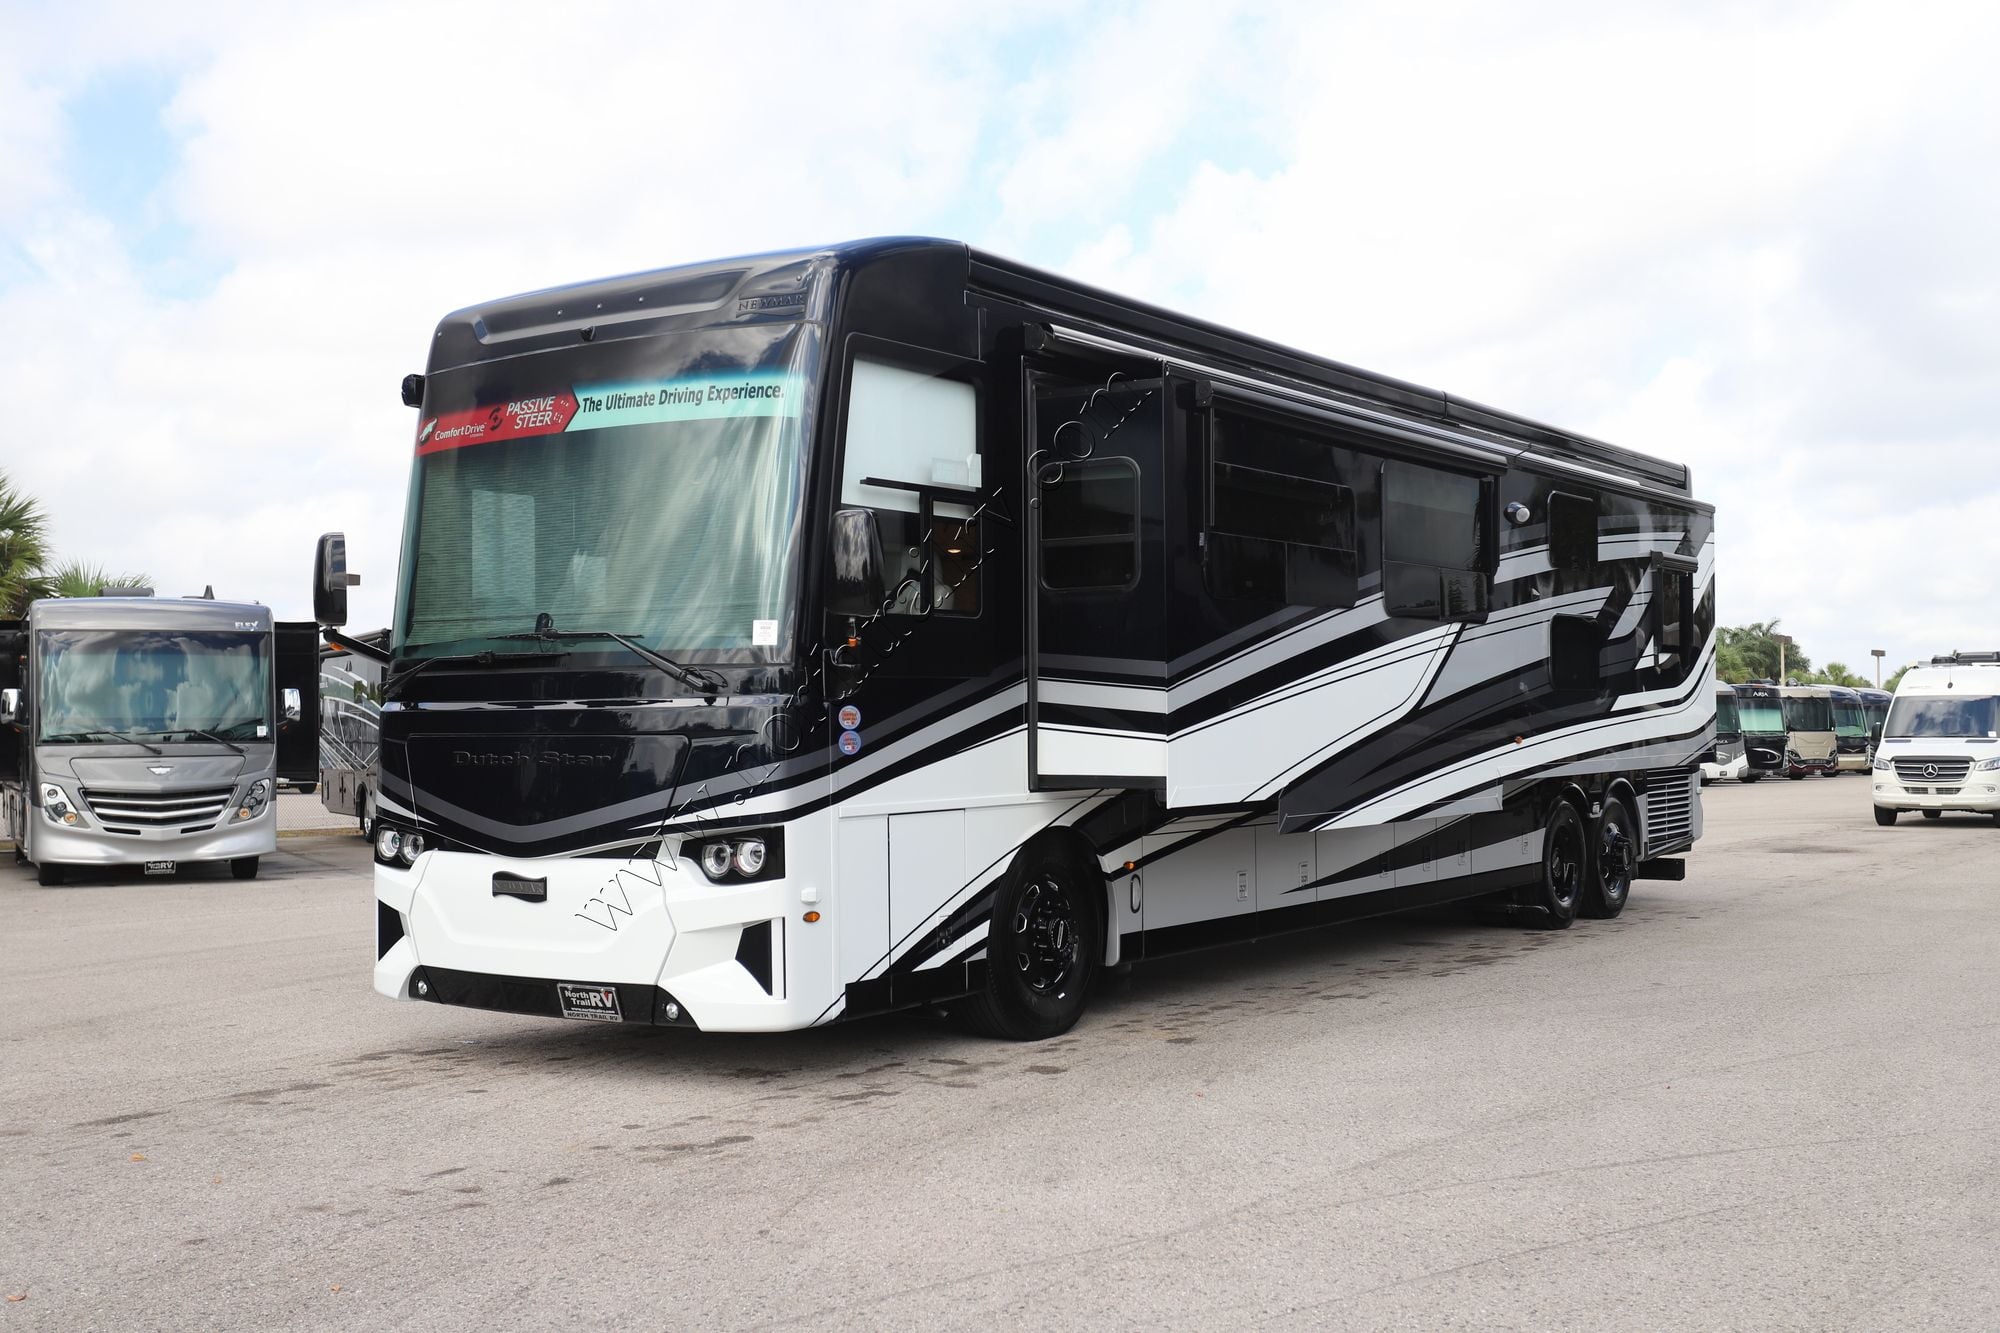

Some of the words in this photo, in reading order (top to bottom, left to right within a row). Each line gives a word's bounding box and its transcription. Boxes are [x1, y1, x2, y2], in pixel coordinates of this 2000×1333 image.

[506, 396, 556, 416] PASSIVE
[582, 398, 603, 413] The
[605, 391, 655, 411] Ultimate
[658, 387, 703, 406] Driving
[707, 382, 785, 404] Experience.
[514, 411, 552, 429] STEER
[434, 426, 465, 441] Comfort
[464, 423, 485, 435] Drive
[453, 751, 530, 766] Dutch
[538, 751, 612, 765] Star
[564, 990, 589, 999] North
[571, 998, 590, 1006] Trail
[589, 991, 613, 1008] RV
